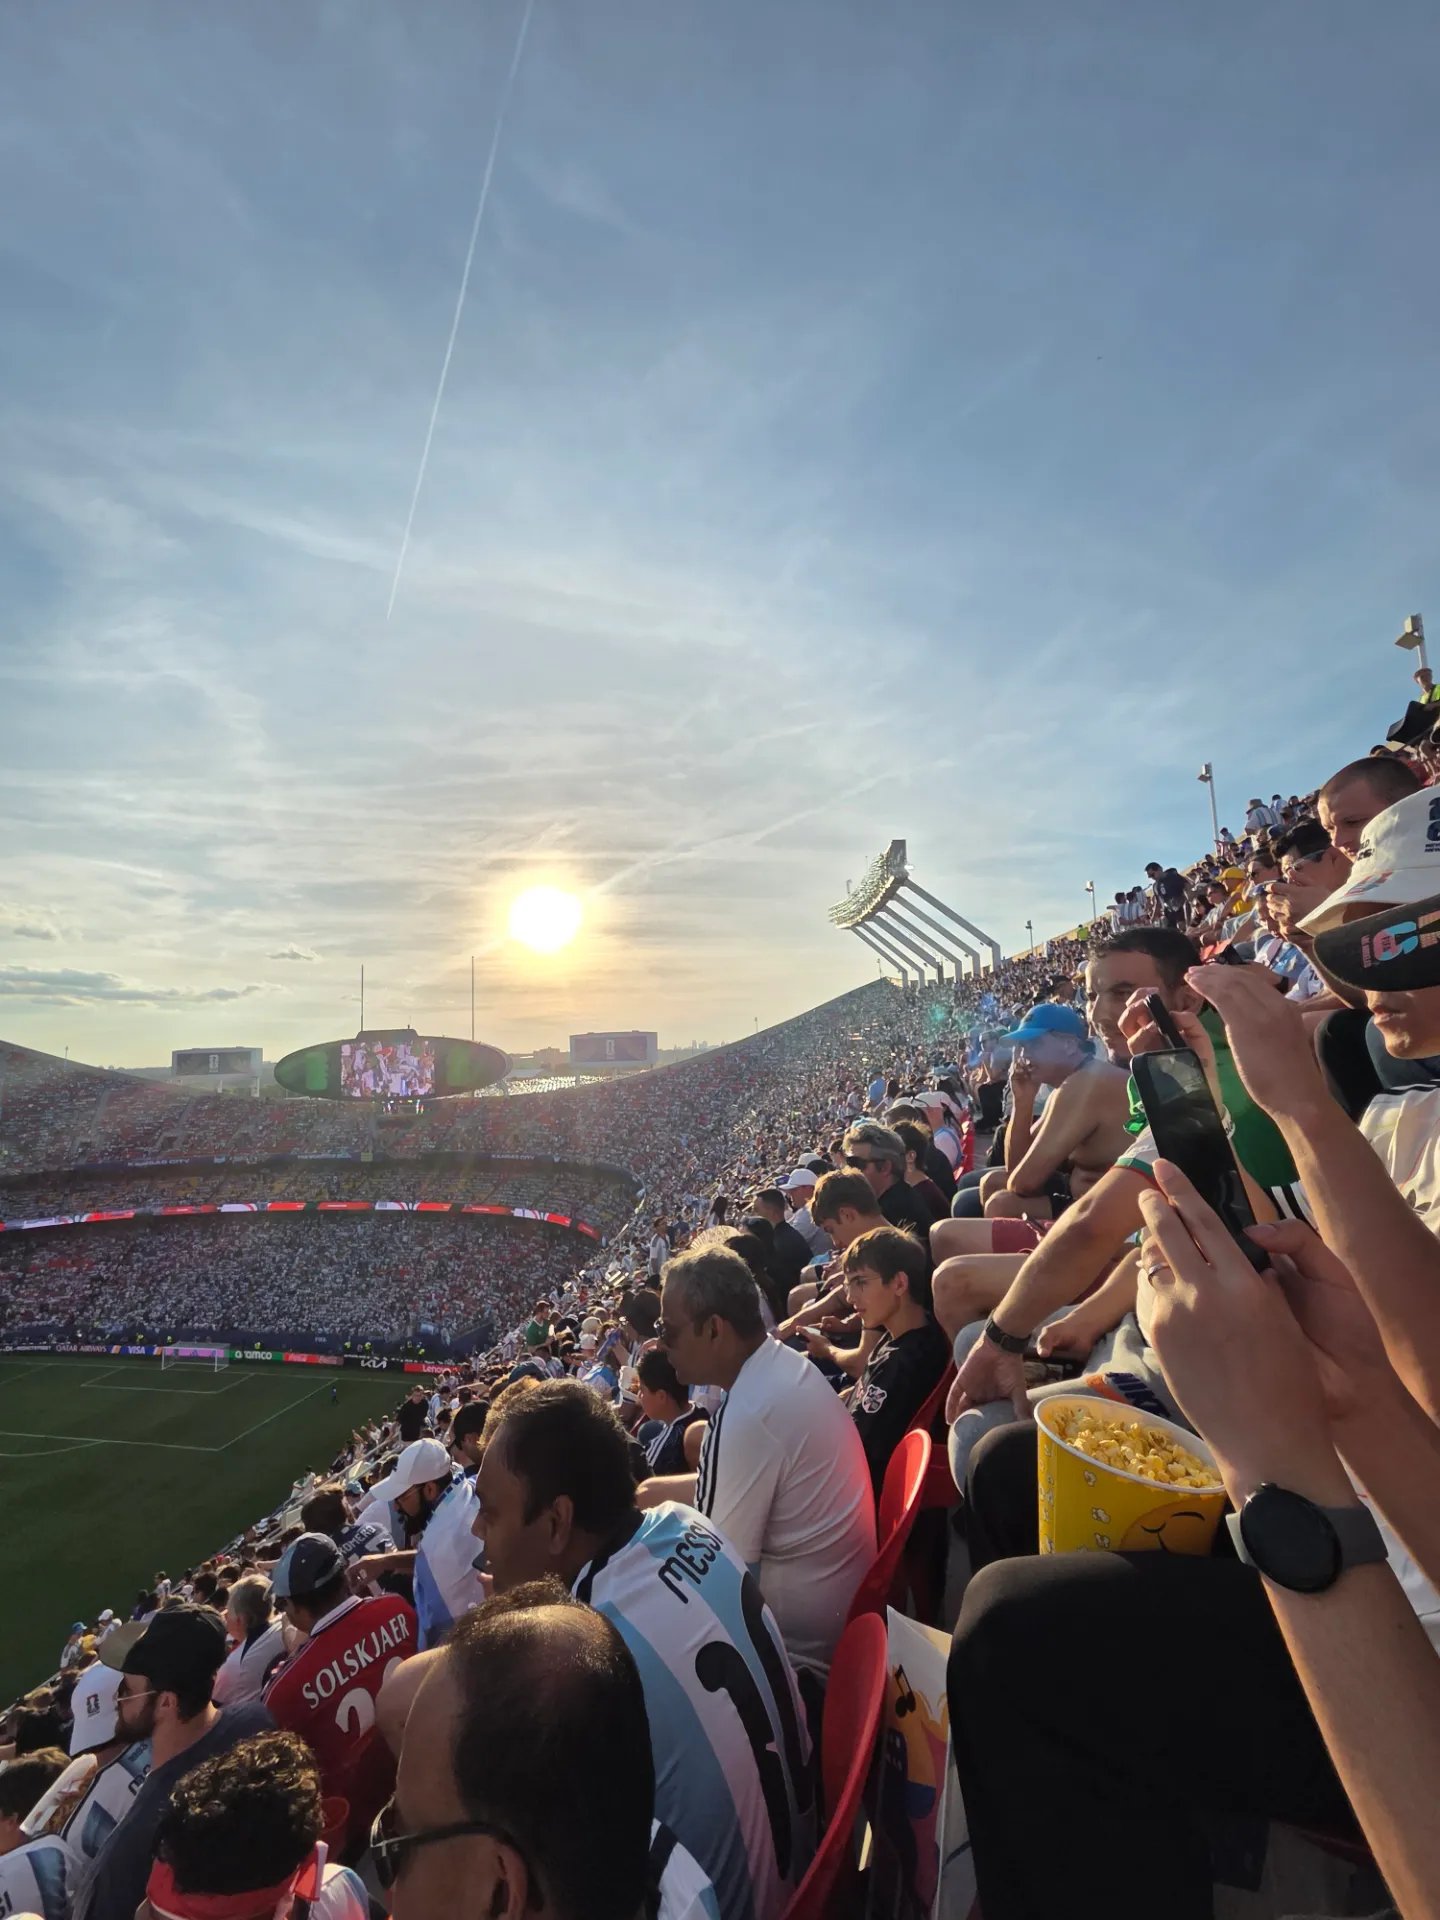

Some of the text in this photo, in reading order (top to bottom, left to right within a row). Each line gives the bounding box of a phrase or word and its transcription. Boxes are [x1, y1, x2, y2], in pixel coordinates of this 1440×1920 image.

[80, 1345, 107, 1353] AIRWAYS
[128, 1346, 146, 1354] VISA
[235, 1350, 272, 1360] aramco
[339, 1525, 377, 1555] ROMERO
[657, 1520, 724, 1605] MESSI
[302, 1613, 410, 1709] SOLSKJAER
